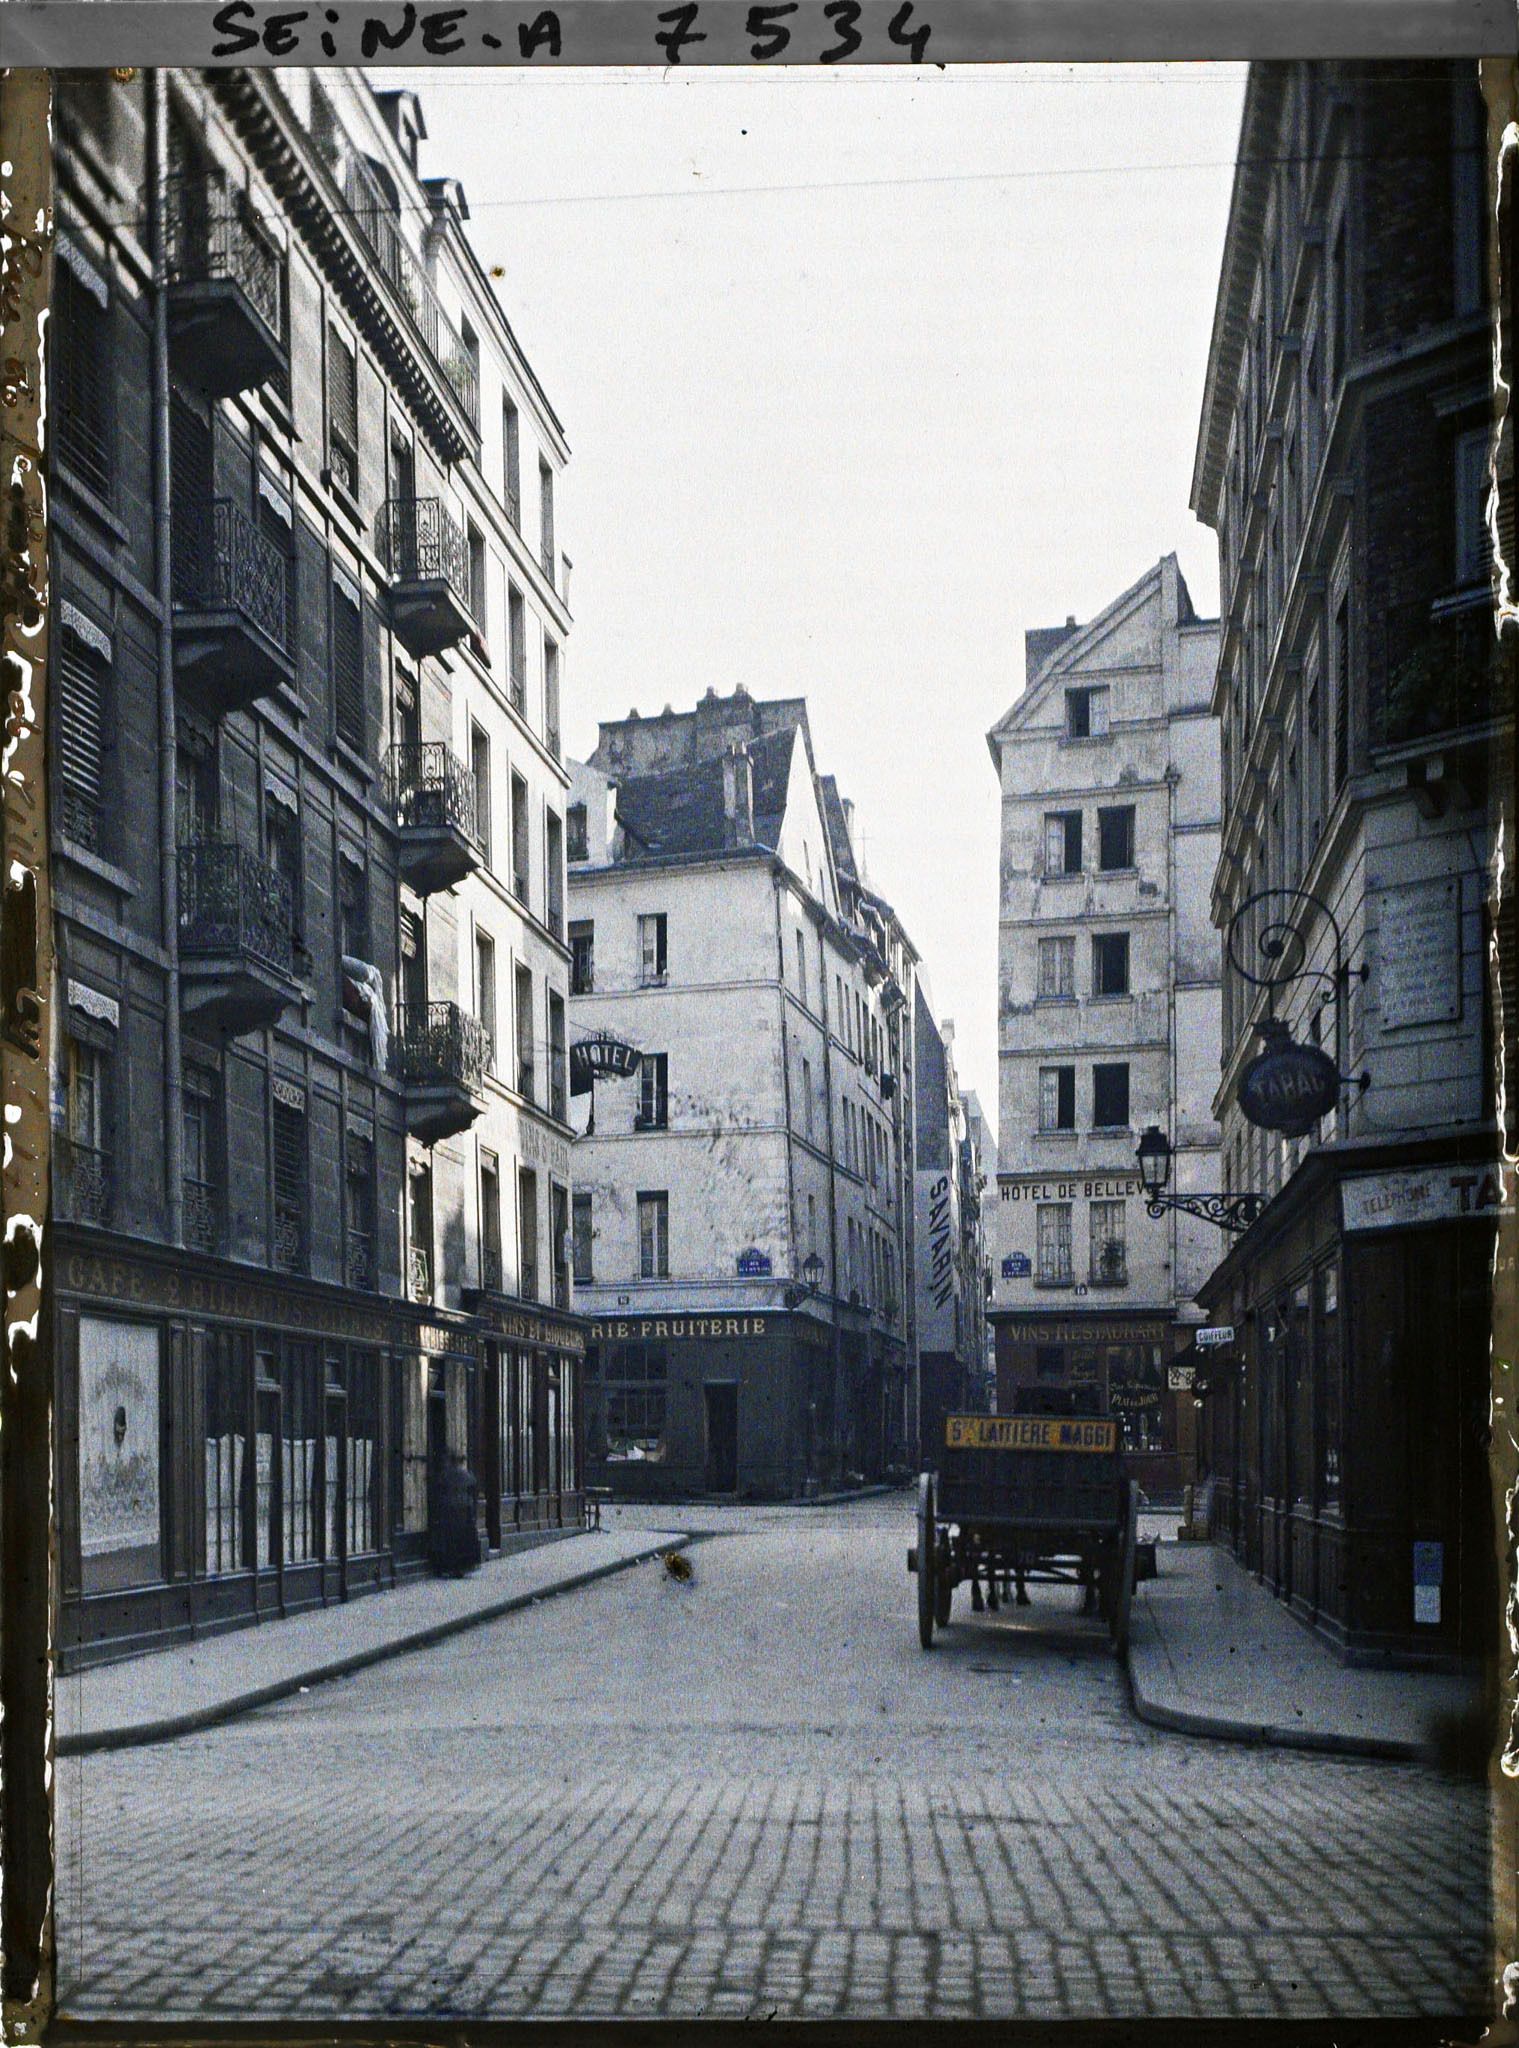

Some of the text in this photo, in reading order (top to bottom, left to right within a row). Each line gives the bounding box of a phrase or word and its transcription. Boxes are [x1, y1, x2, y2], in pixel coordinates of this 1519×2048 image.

[1001, 1184, 1052, 1201] HOTEL
[1058, 1183, 1077, 1199] DE
[928, 1175, 953, 1311] SAVARIN
[641, 1318, 766, 1337] FRUITERIE
[1060, 1423, 1113, 1447] MAGGI
